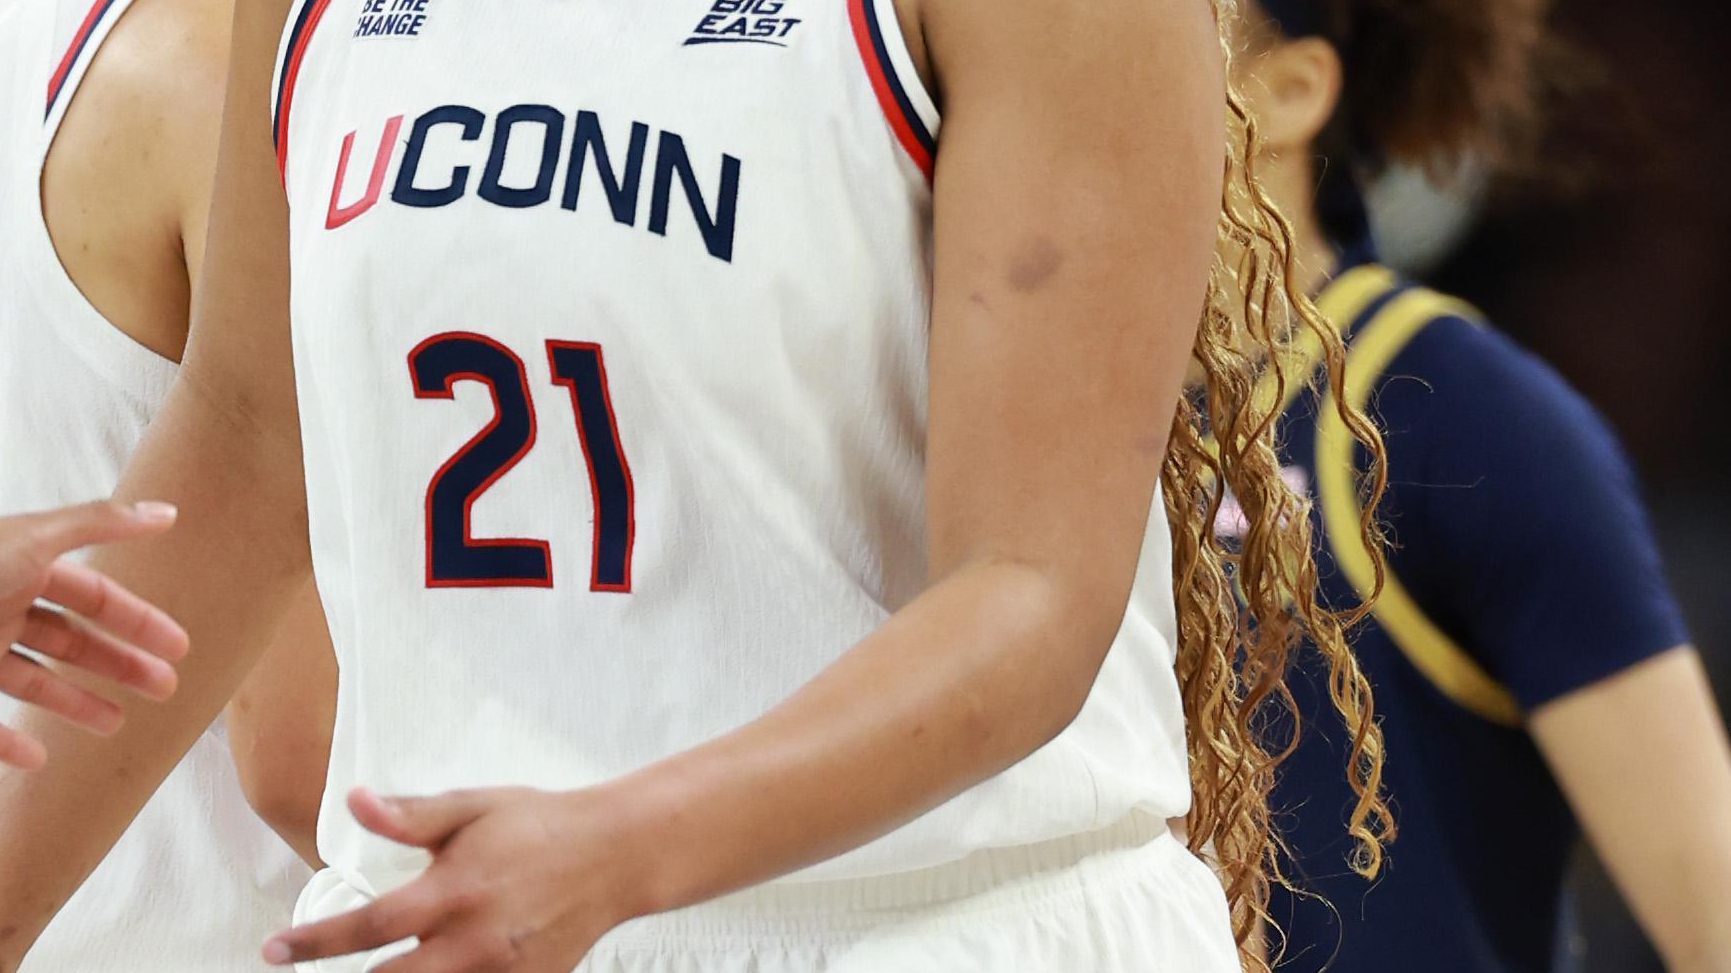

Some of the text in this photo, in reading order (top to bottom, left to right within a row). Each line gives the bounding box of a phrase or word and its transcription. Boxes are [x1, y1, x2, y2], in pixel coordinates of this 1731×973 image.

[693, 14, 802, 37] EAST
[324, 103, 741, 263] UCONN
[407, 331, 635, 593] 21
